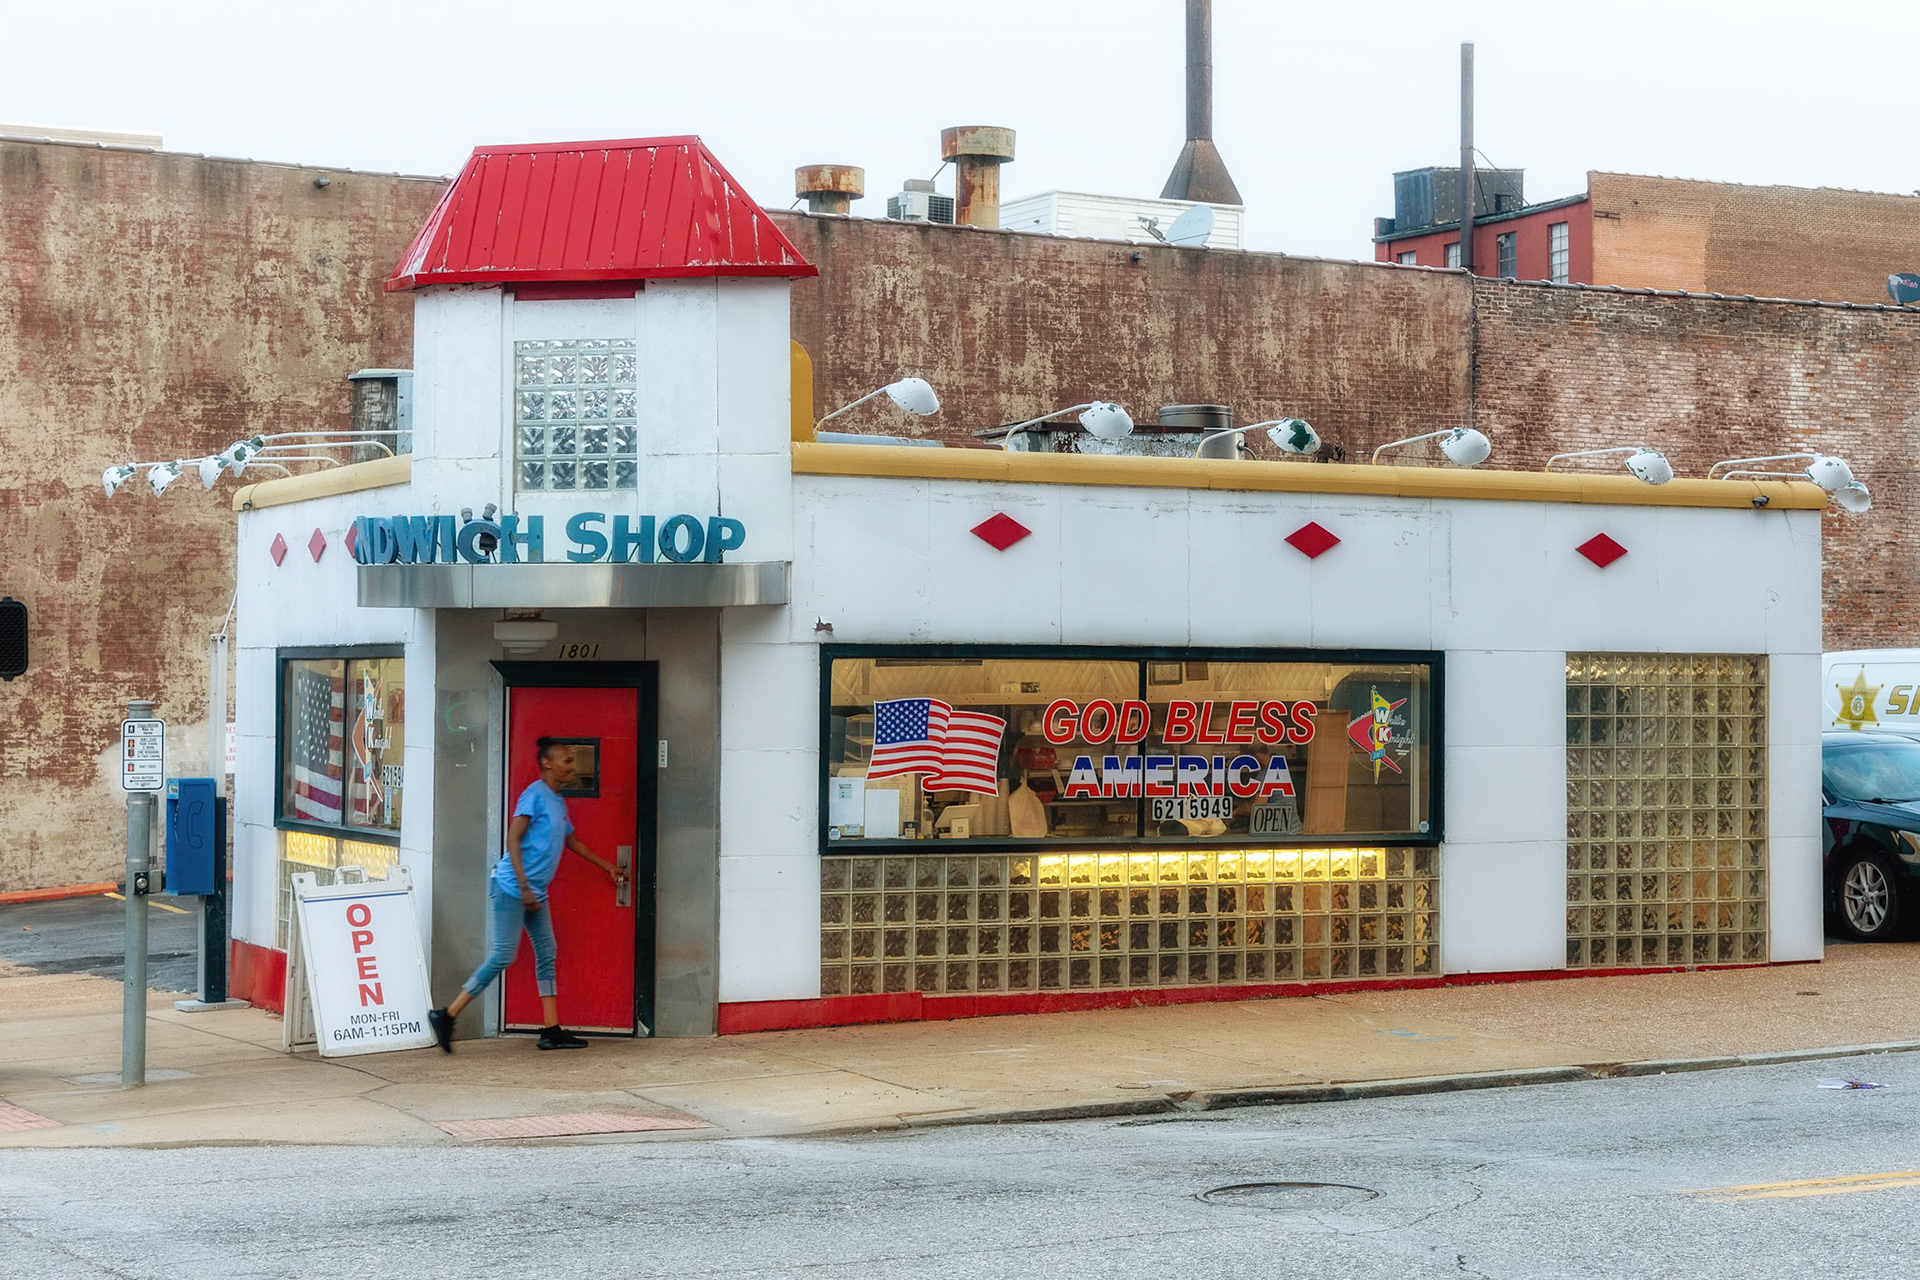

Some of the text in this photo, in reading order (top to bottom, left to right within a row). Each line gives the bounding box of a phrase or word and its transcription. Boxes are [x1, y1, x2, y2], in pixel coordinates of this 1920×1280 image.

[354, 511, 747, 564] NDWICH SHOP
[559, 644, 600, 659] 1801
[1042, 698, 1318, 745] GOD BLESS
[1063, 755, 1296, 798] AMERICA
[1254, 807, 1291, 833] OPEN
[346, 903, 385, 1007] OPEN
[333, 1021, 422, 1042] 6AM-1:15PM
[350, 1011, 401, 1025] MON-FRI
